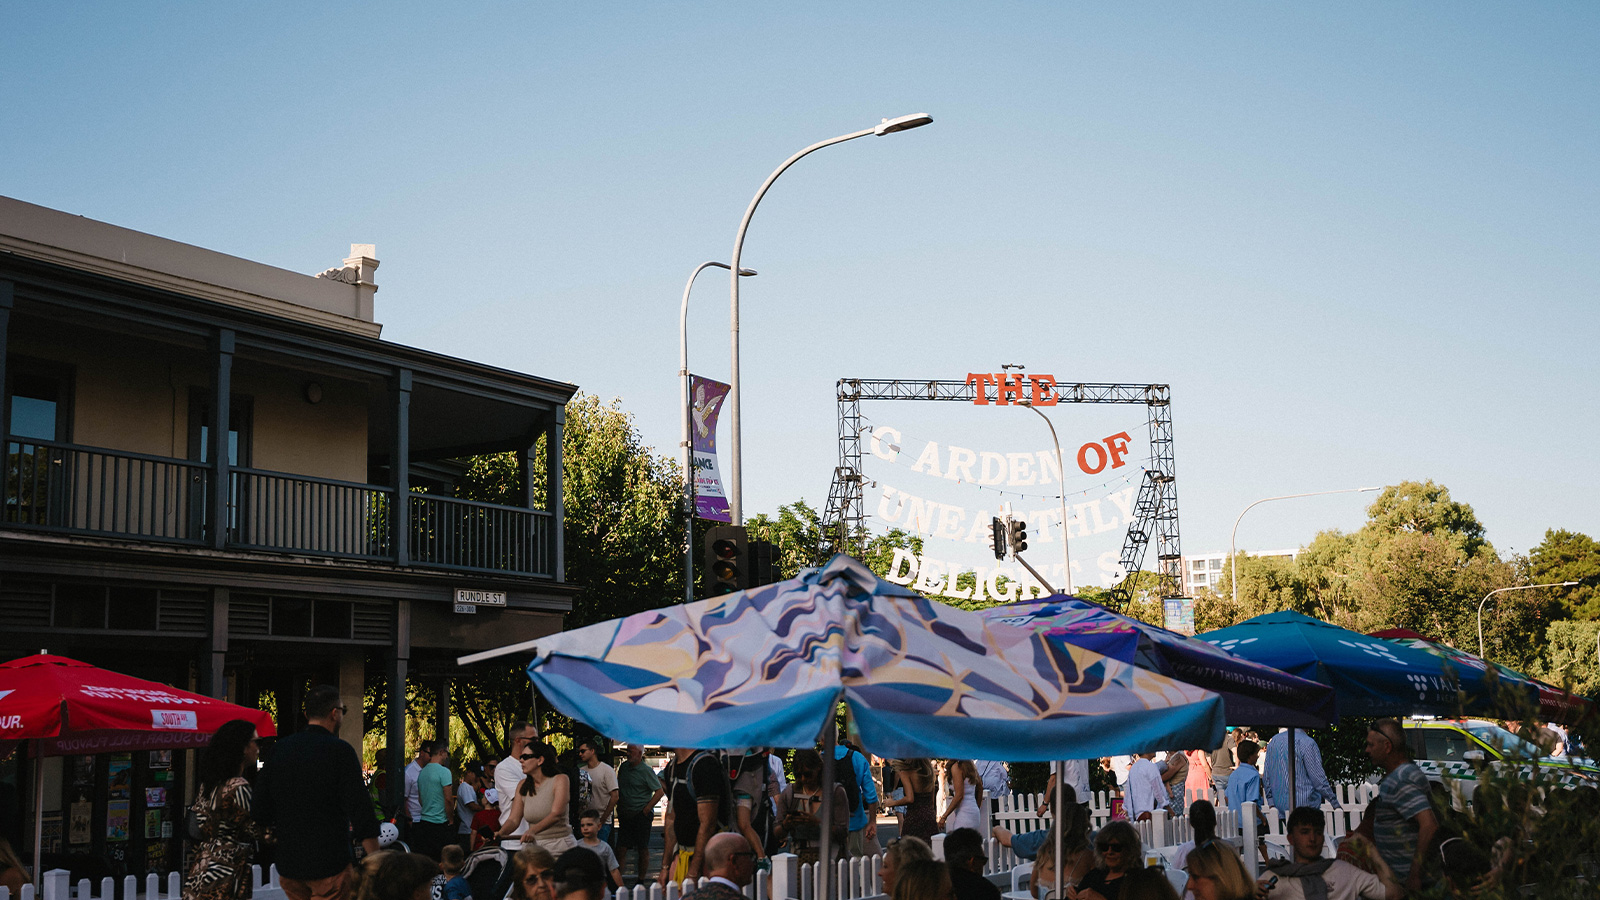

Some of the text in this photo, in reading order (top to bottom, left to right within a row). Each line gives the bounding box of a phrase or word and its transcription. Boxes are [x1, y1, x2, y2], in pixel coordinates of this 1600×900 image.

[966, 372, 1059, 406] THE
[870, 426, 1132, 487] GARDEN OF
[877, 484, 1136, 544] UNEATHLY
[460, 591, 490, 603] RUNDLE
[1219, 669, 1245, 684] THIRD
[1247, 675, 1276, 691] STREET
[1430, 676, 1466, 692] VALE
[0, 715, 24, 729] UR.
[160, 712, 182, 726] SOUTH
